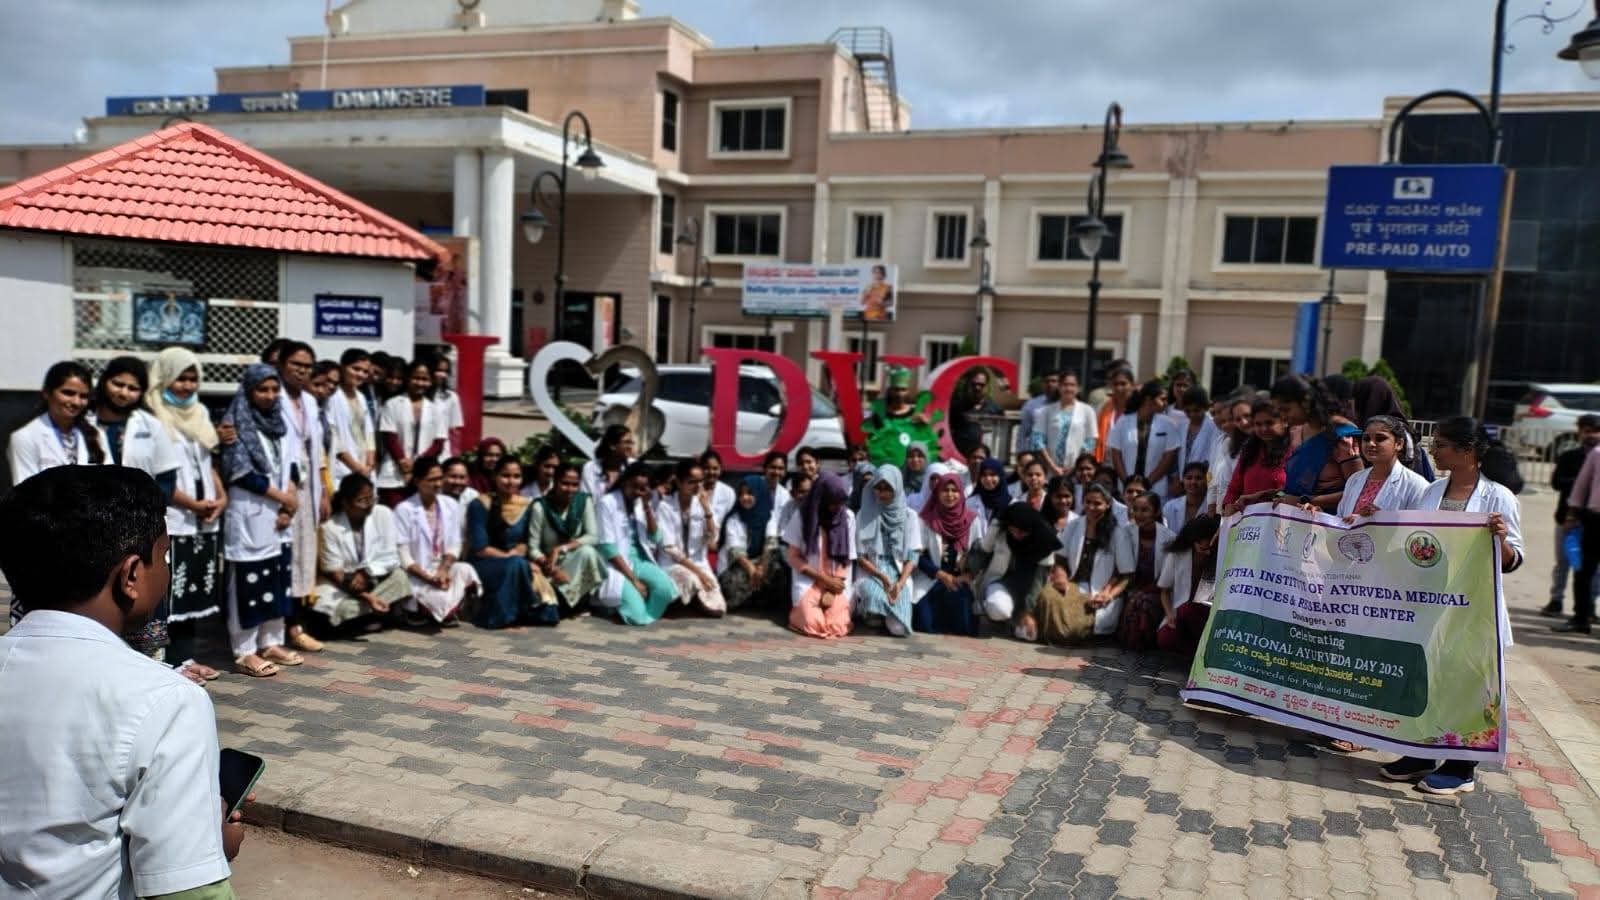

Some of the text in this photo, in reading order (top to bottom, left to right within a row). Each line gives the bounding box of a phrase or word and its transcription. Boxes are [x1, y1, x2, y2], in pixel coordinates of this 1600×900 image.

[333, 87, 452, 109] DAVANGERE
[1345, 242, 1471, 257] PRE-PAID AUTO
[320, 324, 377, 335] NO SMOKING
[1229, 584, 1416, 623] SCIENCES & RESEARCH CENTER
[1308, 584, 1324, 595] OF
[1330, 584, 1402, 601] AYURVEDA
[1405, 590, 1470, 606] MEDICAL
[1335, 618, 1346, 628] 05
[1289, 627, 1345, 650] Celebrating
[1226, 629, 1293, 655] NATIONAL
[1295, 646, 1351, 668] AYURVEDA
[1354, 657, 1378, 673] DAY
[1378, 662, 1404, 678] 2025
[1287, 674, 1299, 685] for
[1327, 688, 1342, 696] and
